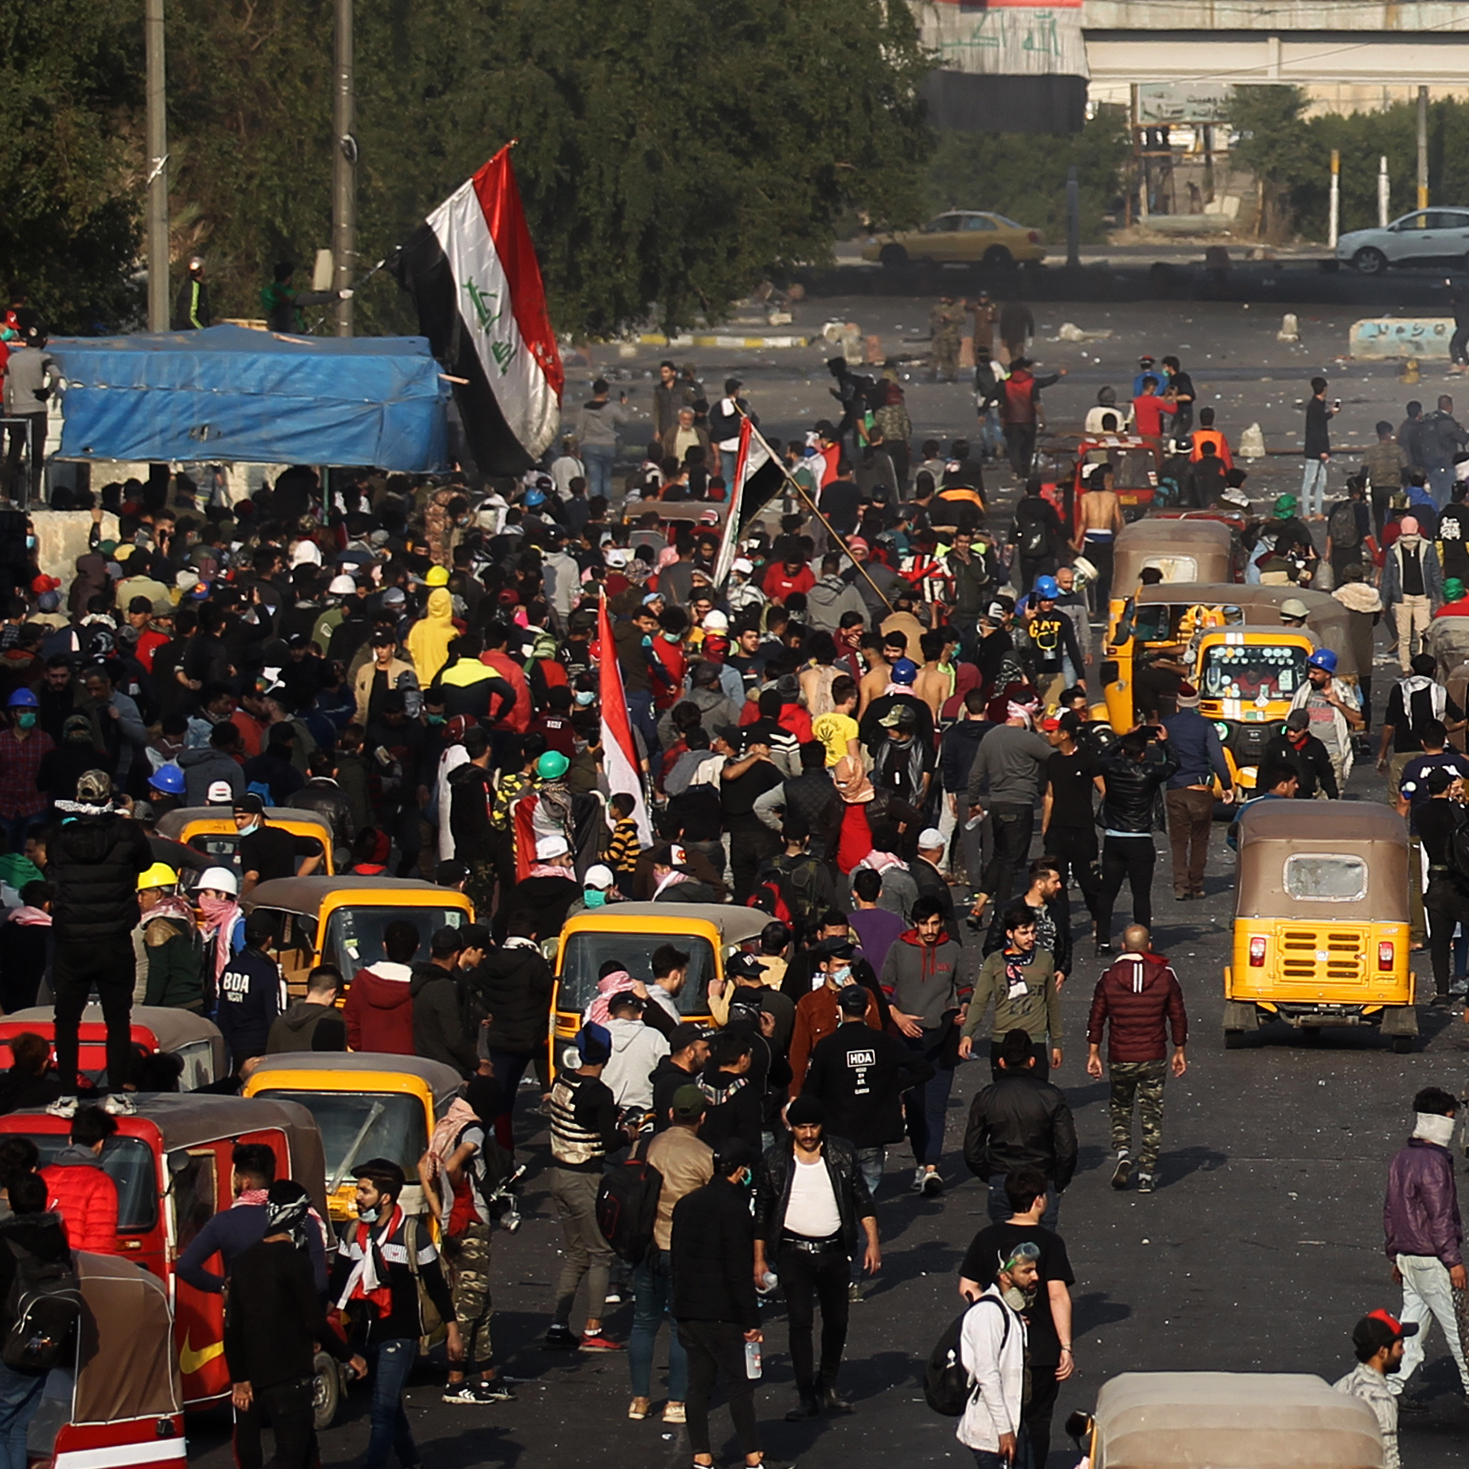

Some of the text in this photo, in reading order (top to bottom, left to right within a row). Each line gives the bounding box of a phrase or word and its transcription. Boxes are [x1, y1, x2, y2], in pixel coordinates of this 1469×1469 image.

[1028, 619, 1062, 638] CAT
[222, 971, 250, 994] BDA
[850, 1052, 873, 1065] HDA
